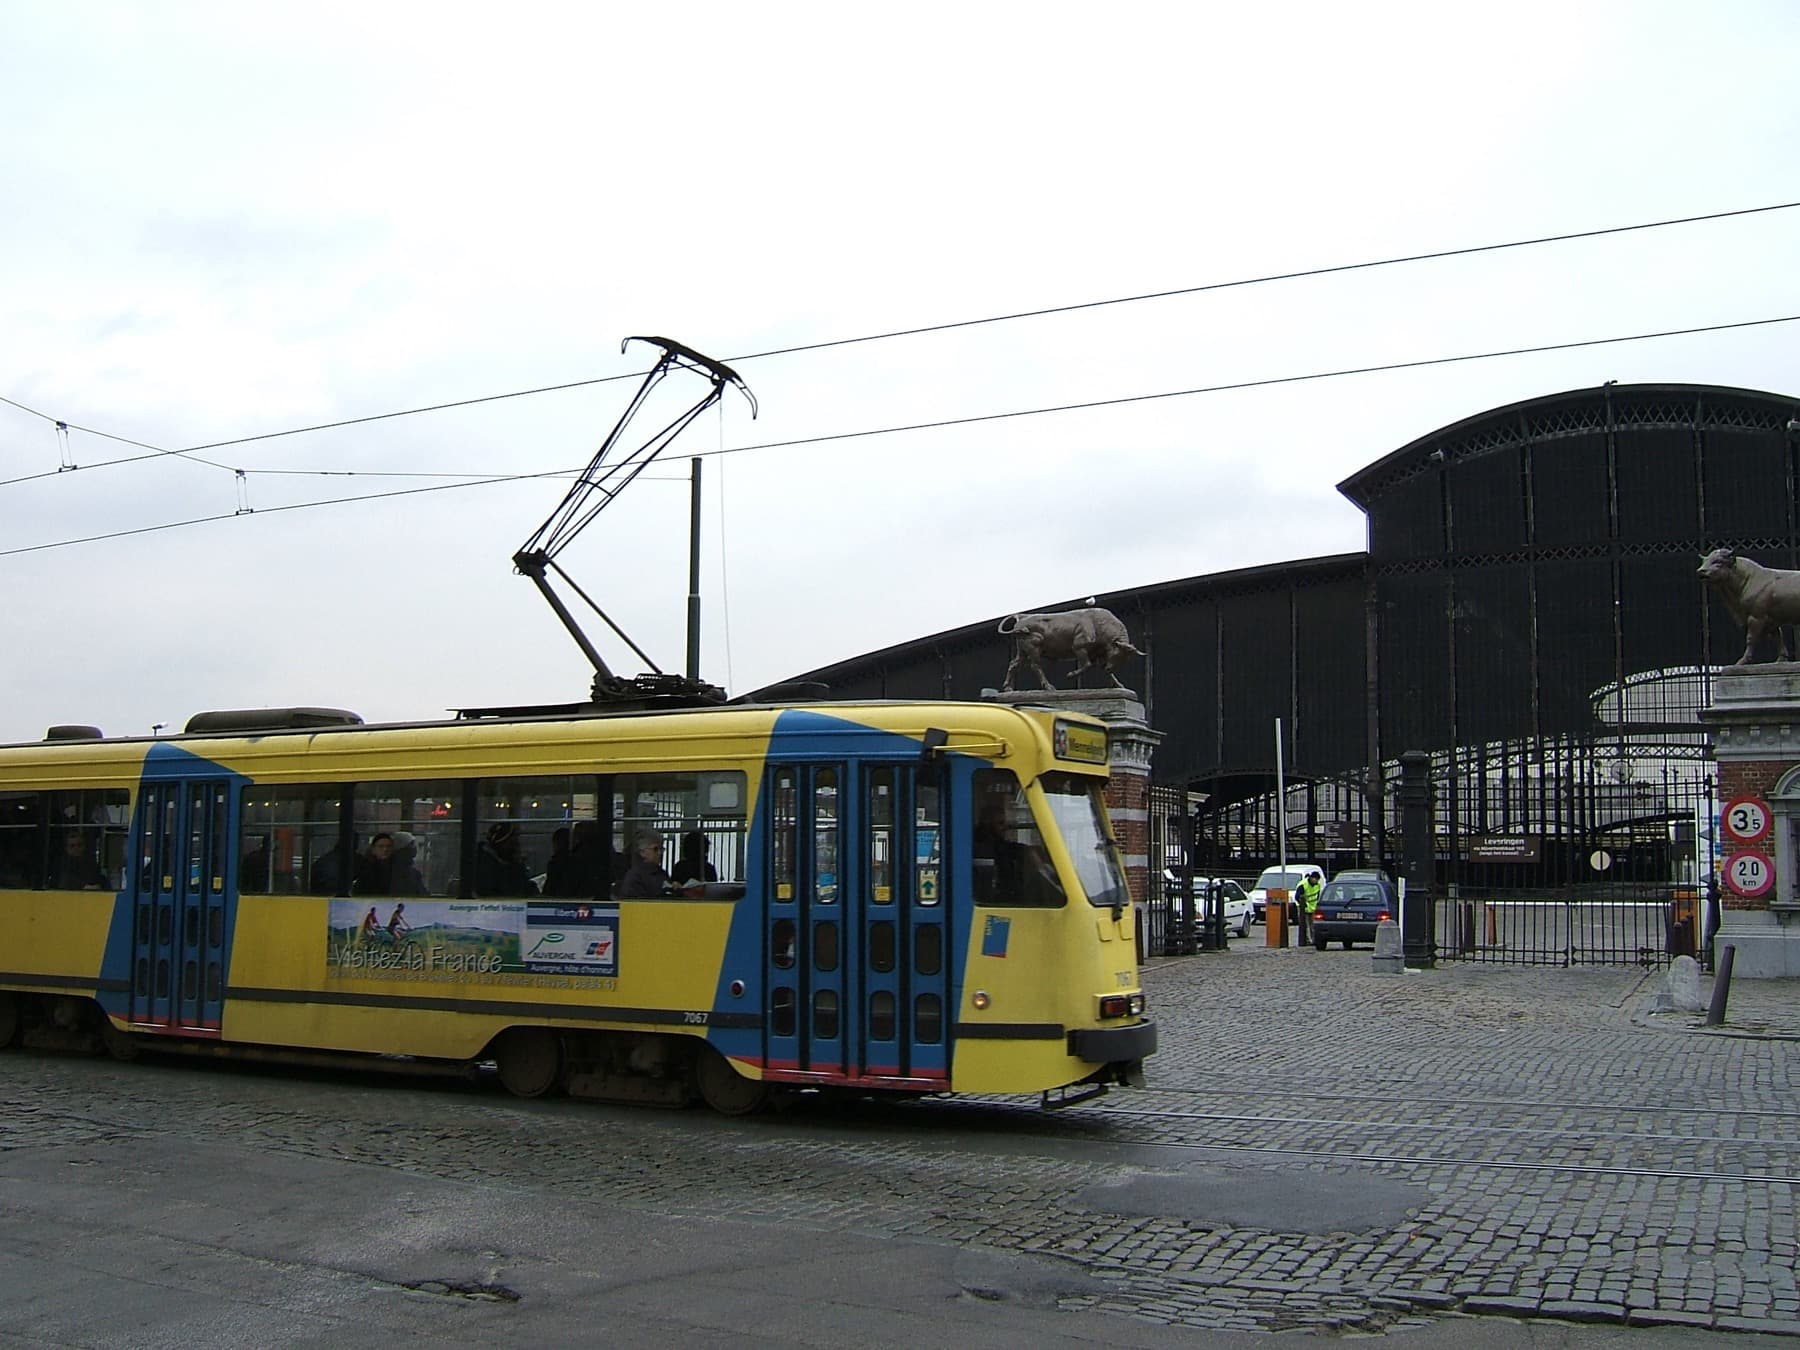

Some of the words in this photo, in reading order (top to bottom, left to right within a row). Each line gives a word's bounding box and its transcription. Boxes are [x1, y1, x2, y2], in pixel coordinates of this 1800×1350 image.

[1739, 861, 1759, 876] 20
[334, 944, 402, 969] Visitez
[404, 948, 425, 970] la
[430, 946, 503, 974] France
[532, 951, 576, 960] AUVERGNE
[683, 1011, 709, 1023] 7067
